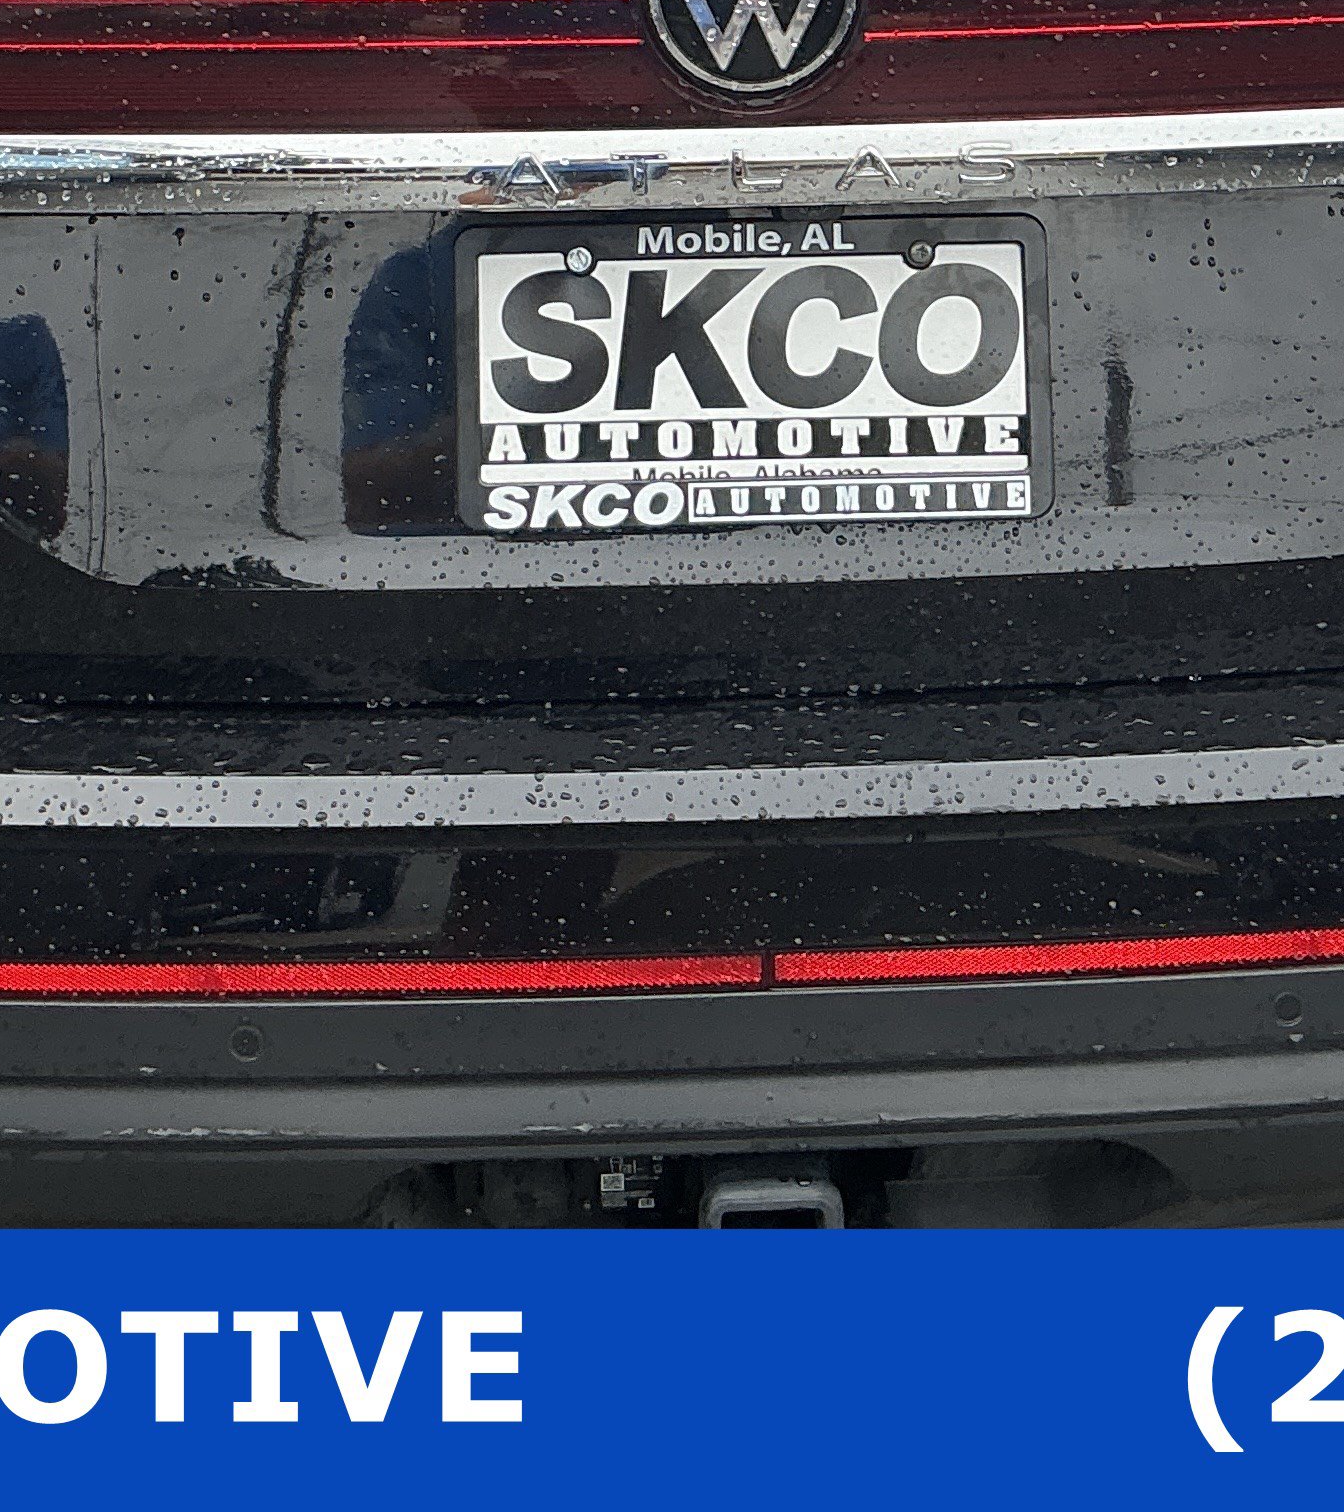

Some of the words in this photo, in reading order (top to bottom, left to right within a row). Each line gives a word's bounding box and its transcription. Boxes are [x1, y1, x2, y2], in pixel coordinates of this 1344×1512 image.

[495, 140, 1016, 195] ATLAS
[637, 225, 791, 257] Mobile,
[800, 222, 855, 252] AL
[490, 262, 1020, 413] SKCO
[488, 415, 1020, 463] AUTOMOTIVE
[483, 481, 685, 530] SKCO
[695, 482, 1027, 517] AUTOMOTIVE
